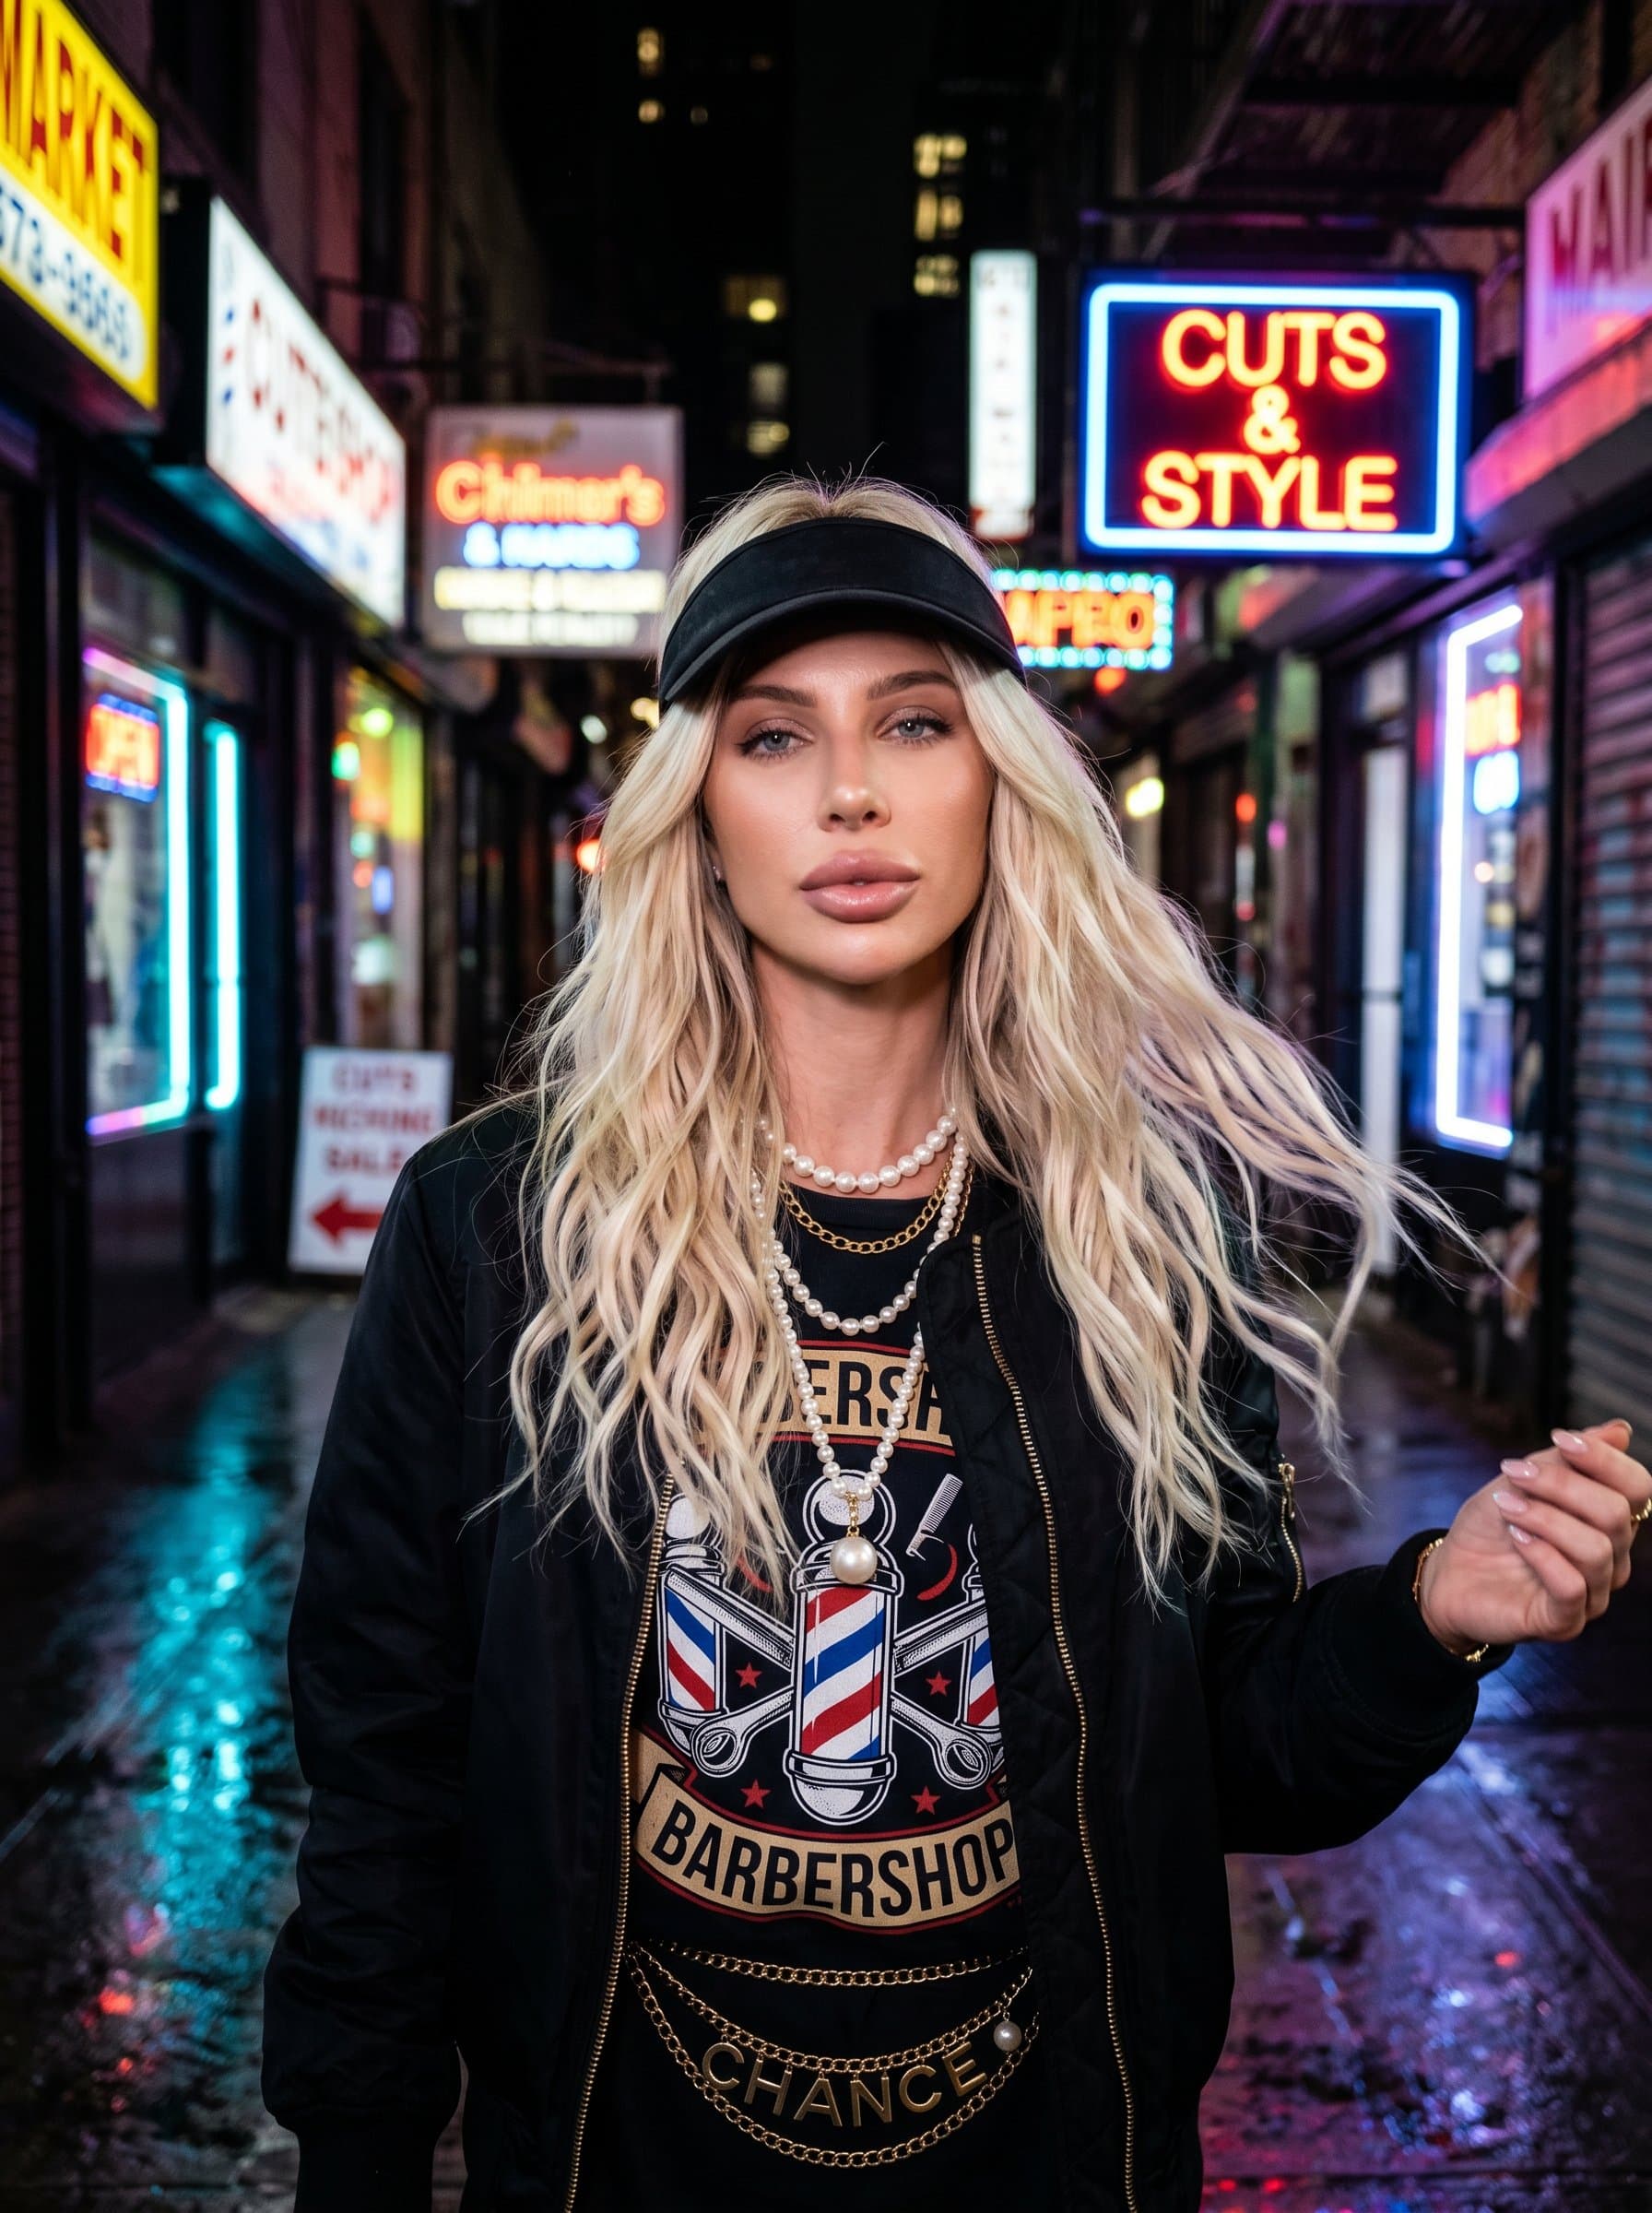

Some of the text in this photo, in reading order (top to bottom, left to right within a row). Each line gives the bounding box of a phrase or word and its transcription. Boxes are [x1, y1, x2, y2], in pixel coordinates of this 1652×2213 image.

[1162, 308, 1387, 390] CUTS
[1243, 383, 1301, 455] &
[1141, 450, 1398, 532] STYLE
[649, 1801, 1015, 1918] BARBERSHOP
[702, 2040, 988, 2127] CHANCE
